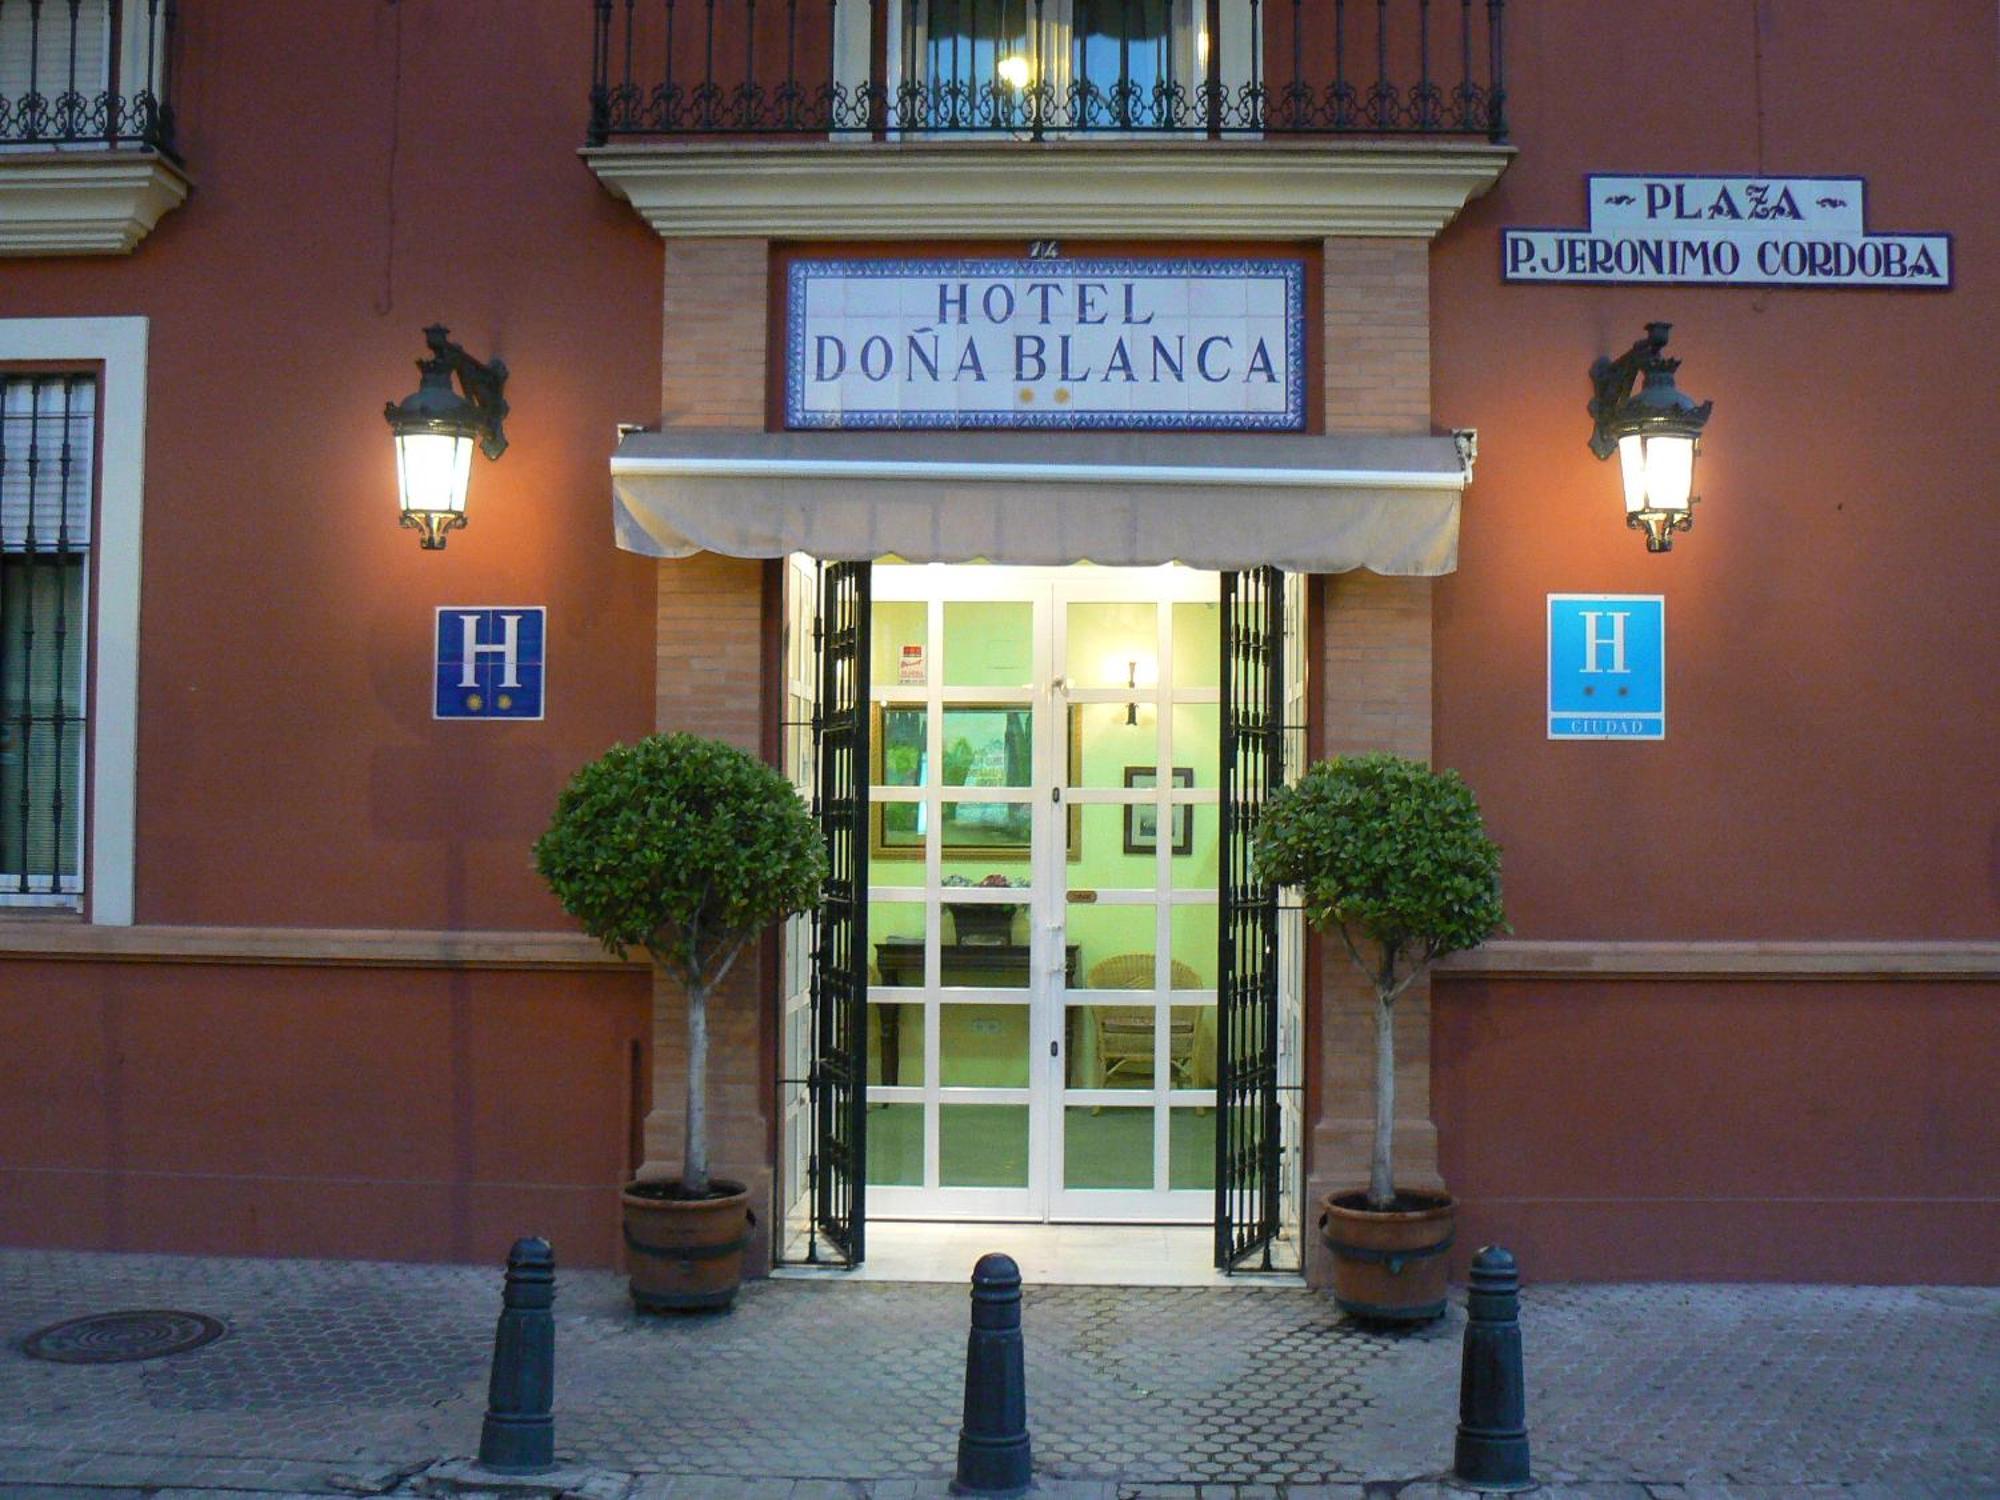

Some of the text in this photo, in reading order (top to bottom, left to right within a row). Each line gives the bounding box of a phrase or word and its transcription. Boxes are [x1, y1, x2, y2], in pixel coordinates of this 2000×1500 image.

[1646, 183, 1805, 221] PLAZA
[1757, 240, 1942, 278] CORDOBA
[937, 283, 1154, 325] HOTEL
[814, 327, 1281, 383] DOÑA BLANCA
[457, 615, 522, 687] H
[1578, 612, 1631, 673] H
[1570, 720, 1644, 734] CIUDAD
